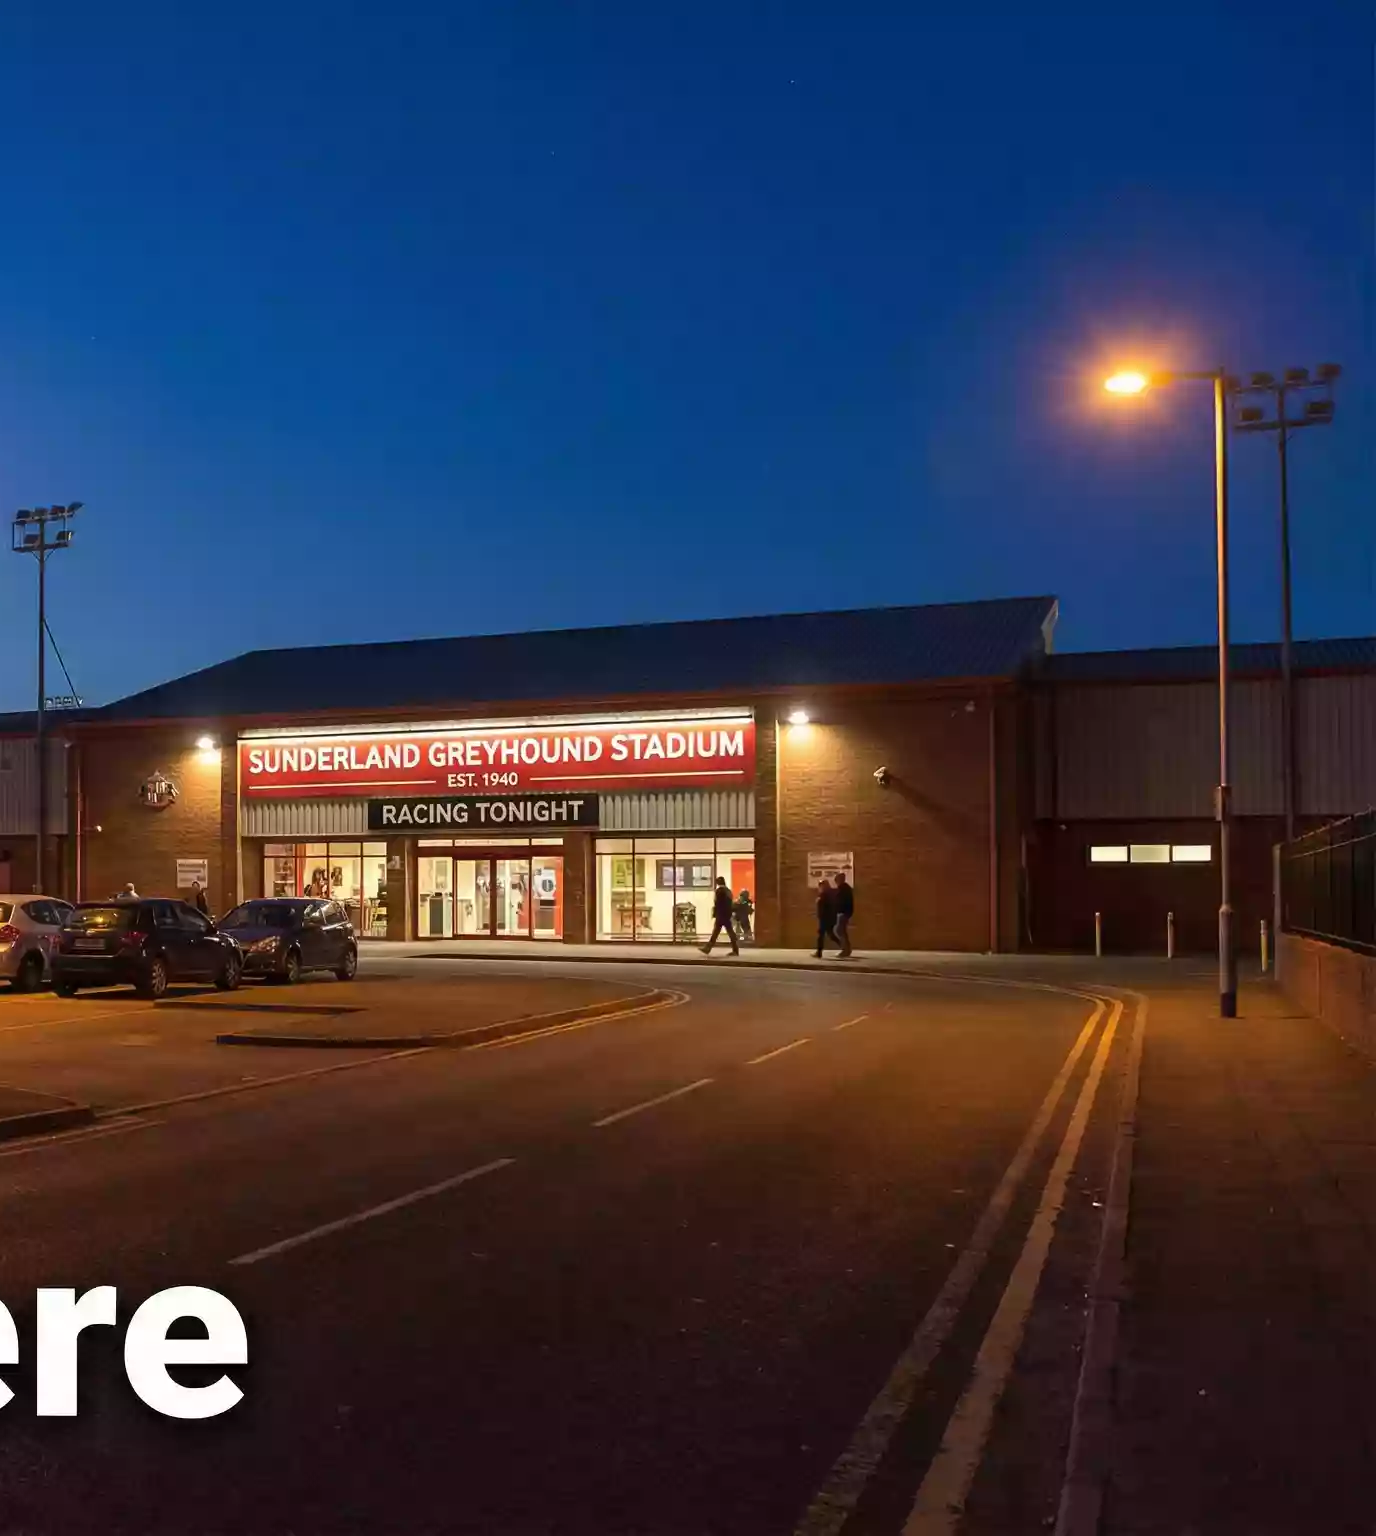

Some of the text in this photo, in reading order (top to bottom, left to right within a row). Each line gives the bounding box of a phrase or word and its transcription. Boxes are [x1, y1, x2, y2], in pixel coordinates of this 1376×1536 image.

[249, 730, 744, 774] SUNDERLAND GREYHOUND STADIUM
[447, 771, 519, 787] EST. 1940
[382, 800, 584, 824] RACING TONIGHT
